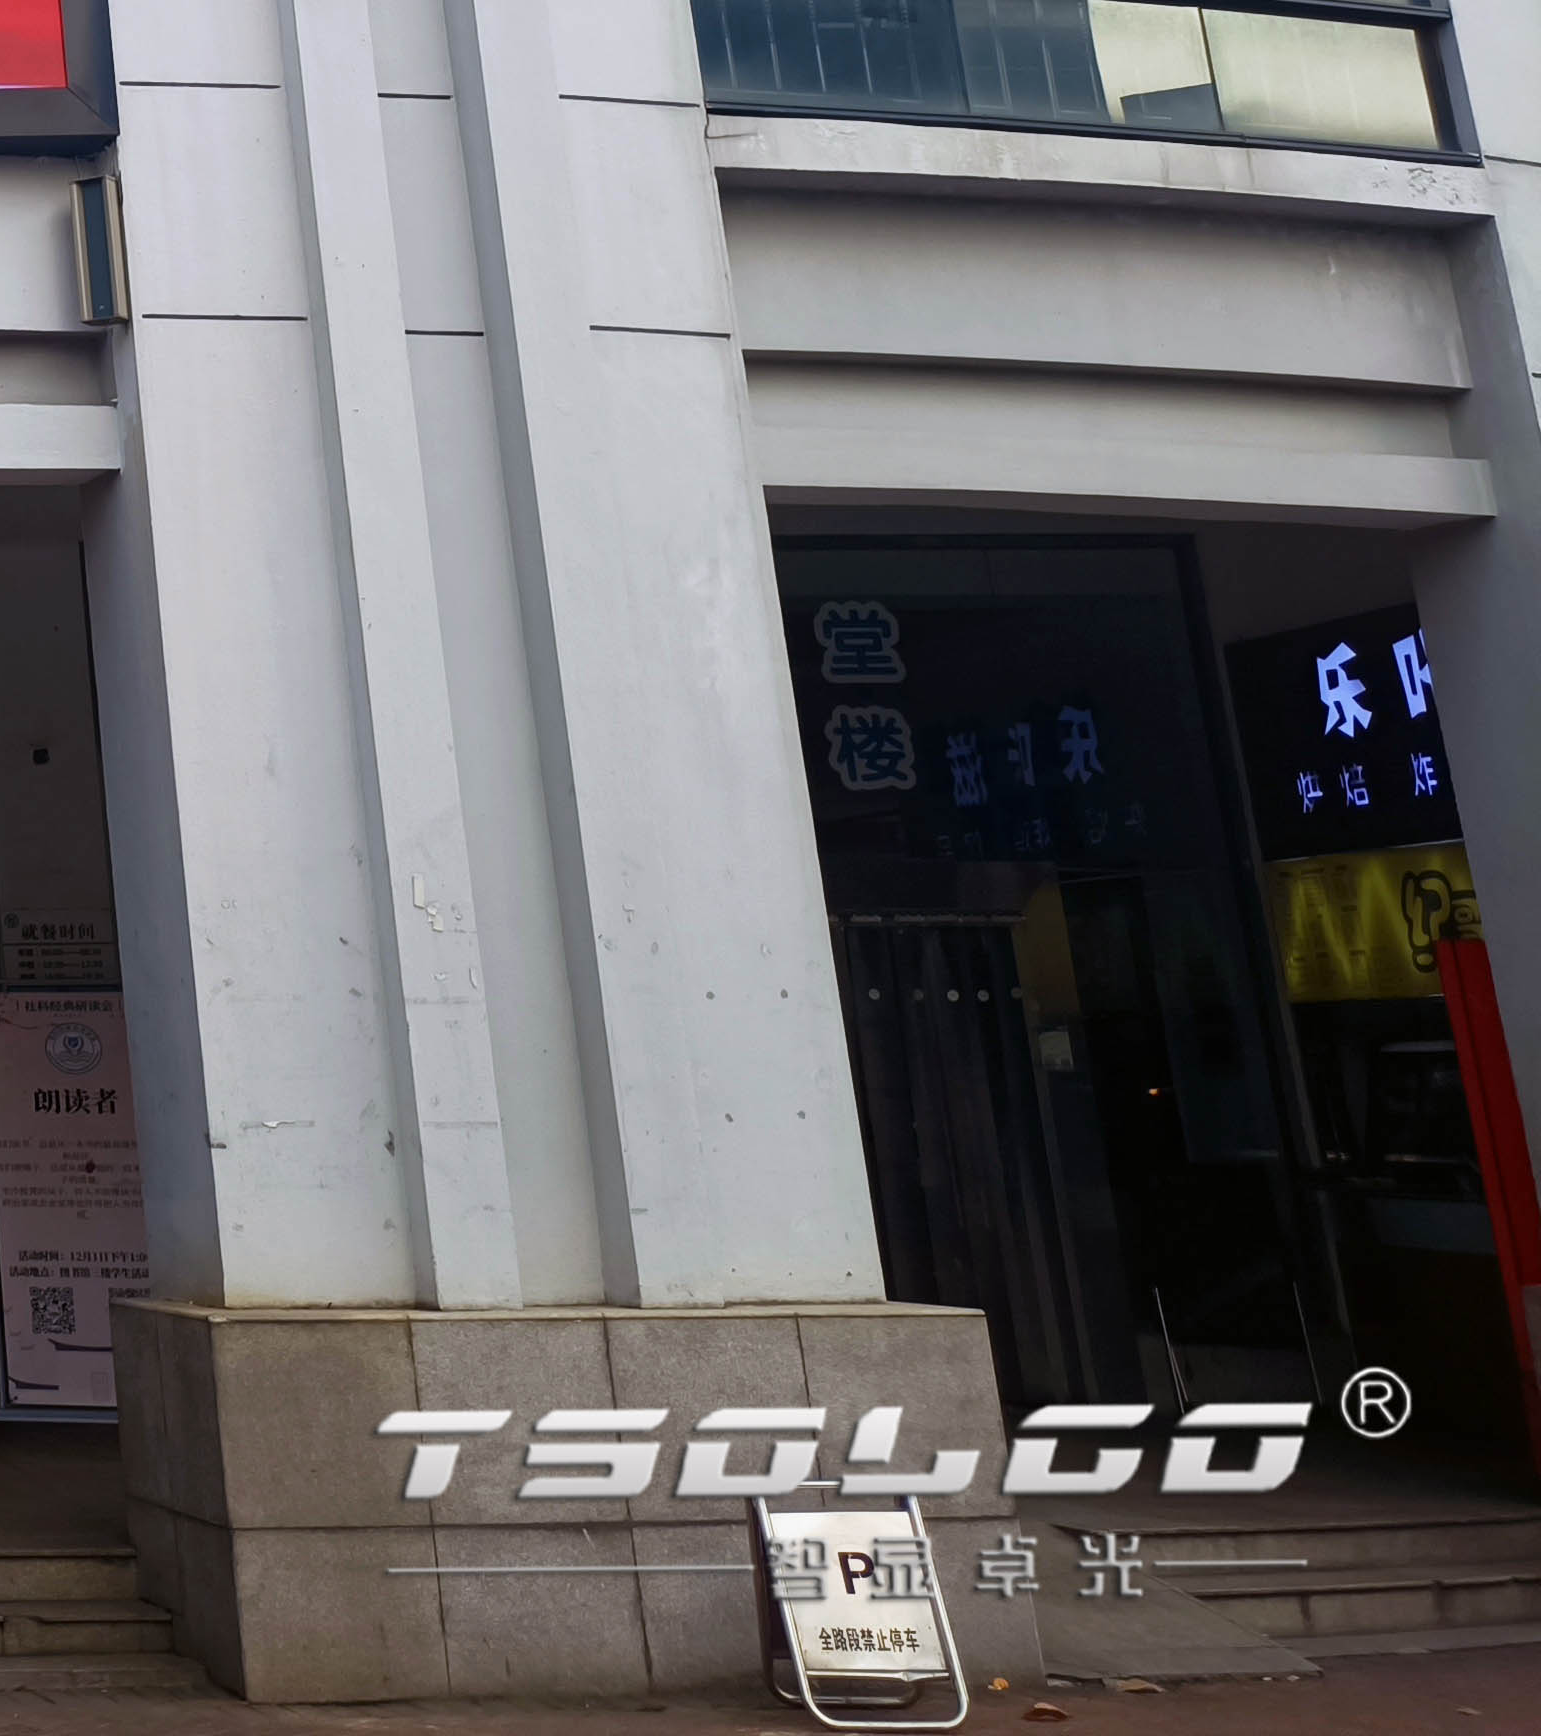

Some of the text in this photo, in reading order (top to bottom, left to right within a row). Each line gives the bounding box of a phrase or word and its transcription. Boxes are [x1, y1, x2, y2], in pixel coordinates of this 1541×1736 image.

[817, 604, 903, 681] 堂
[828, 707, 914, 788] 楼
[33, 1087, 118, 1114] 朗读者
[837, 1551, 875, 1595] P
[818, 1626, 920, 1653] 全路段禁止停车
